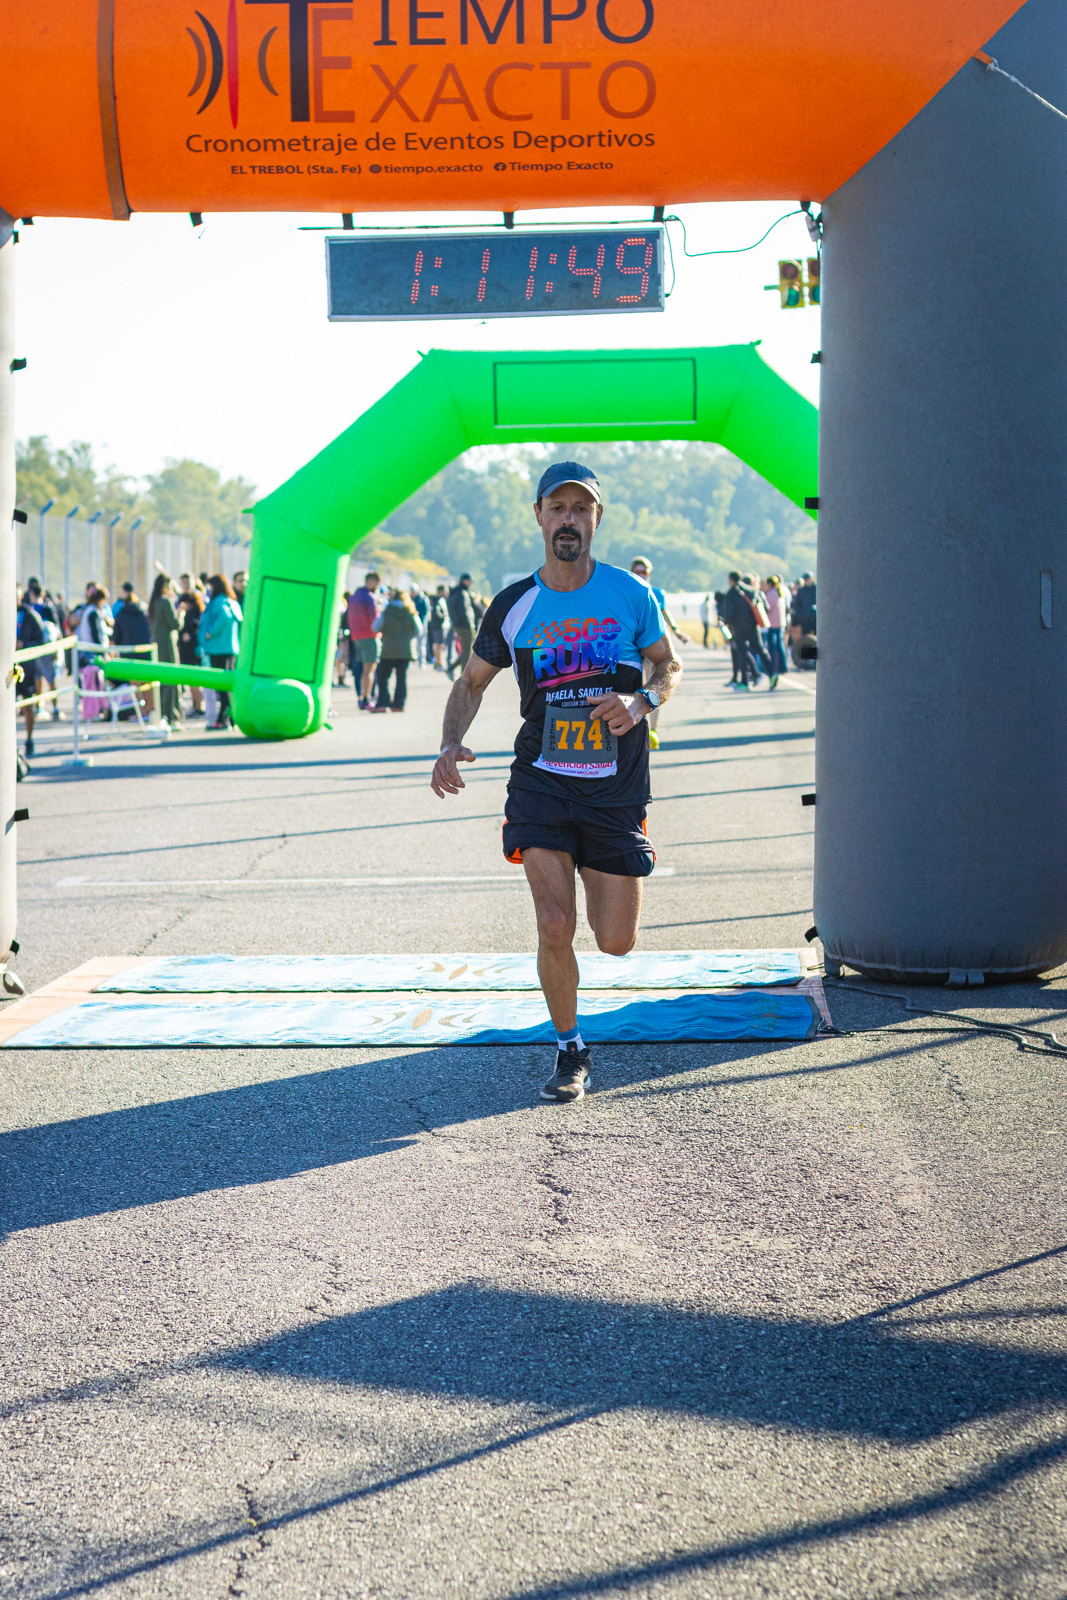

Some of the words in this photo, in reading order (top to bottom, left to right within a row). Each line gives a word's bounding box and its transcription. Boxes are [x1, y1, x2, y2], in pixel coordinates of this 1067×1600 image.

[186, 134, 357, 156] Cronometraje
[365, 132, 396, 151] de
[404, 132, 505, 151] Eventos
[513, 129, 655, 153] Deportivos
[231, 165, 247, 175] EL
[249, 165, 303, 174] TREBOL
[307, 164, 338, 175] (Sta.
[341, 164, 362, 174] Fe)
[384, 163, 483, 175] tiempo.exacto
[509, 162, 563, 173] Tiempo
[566, 161, 614, 170] Exacto
[578, 687, 603, 698] SANTA
[556, 719, 603, 750] 774
